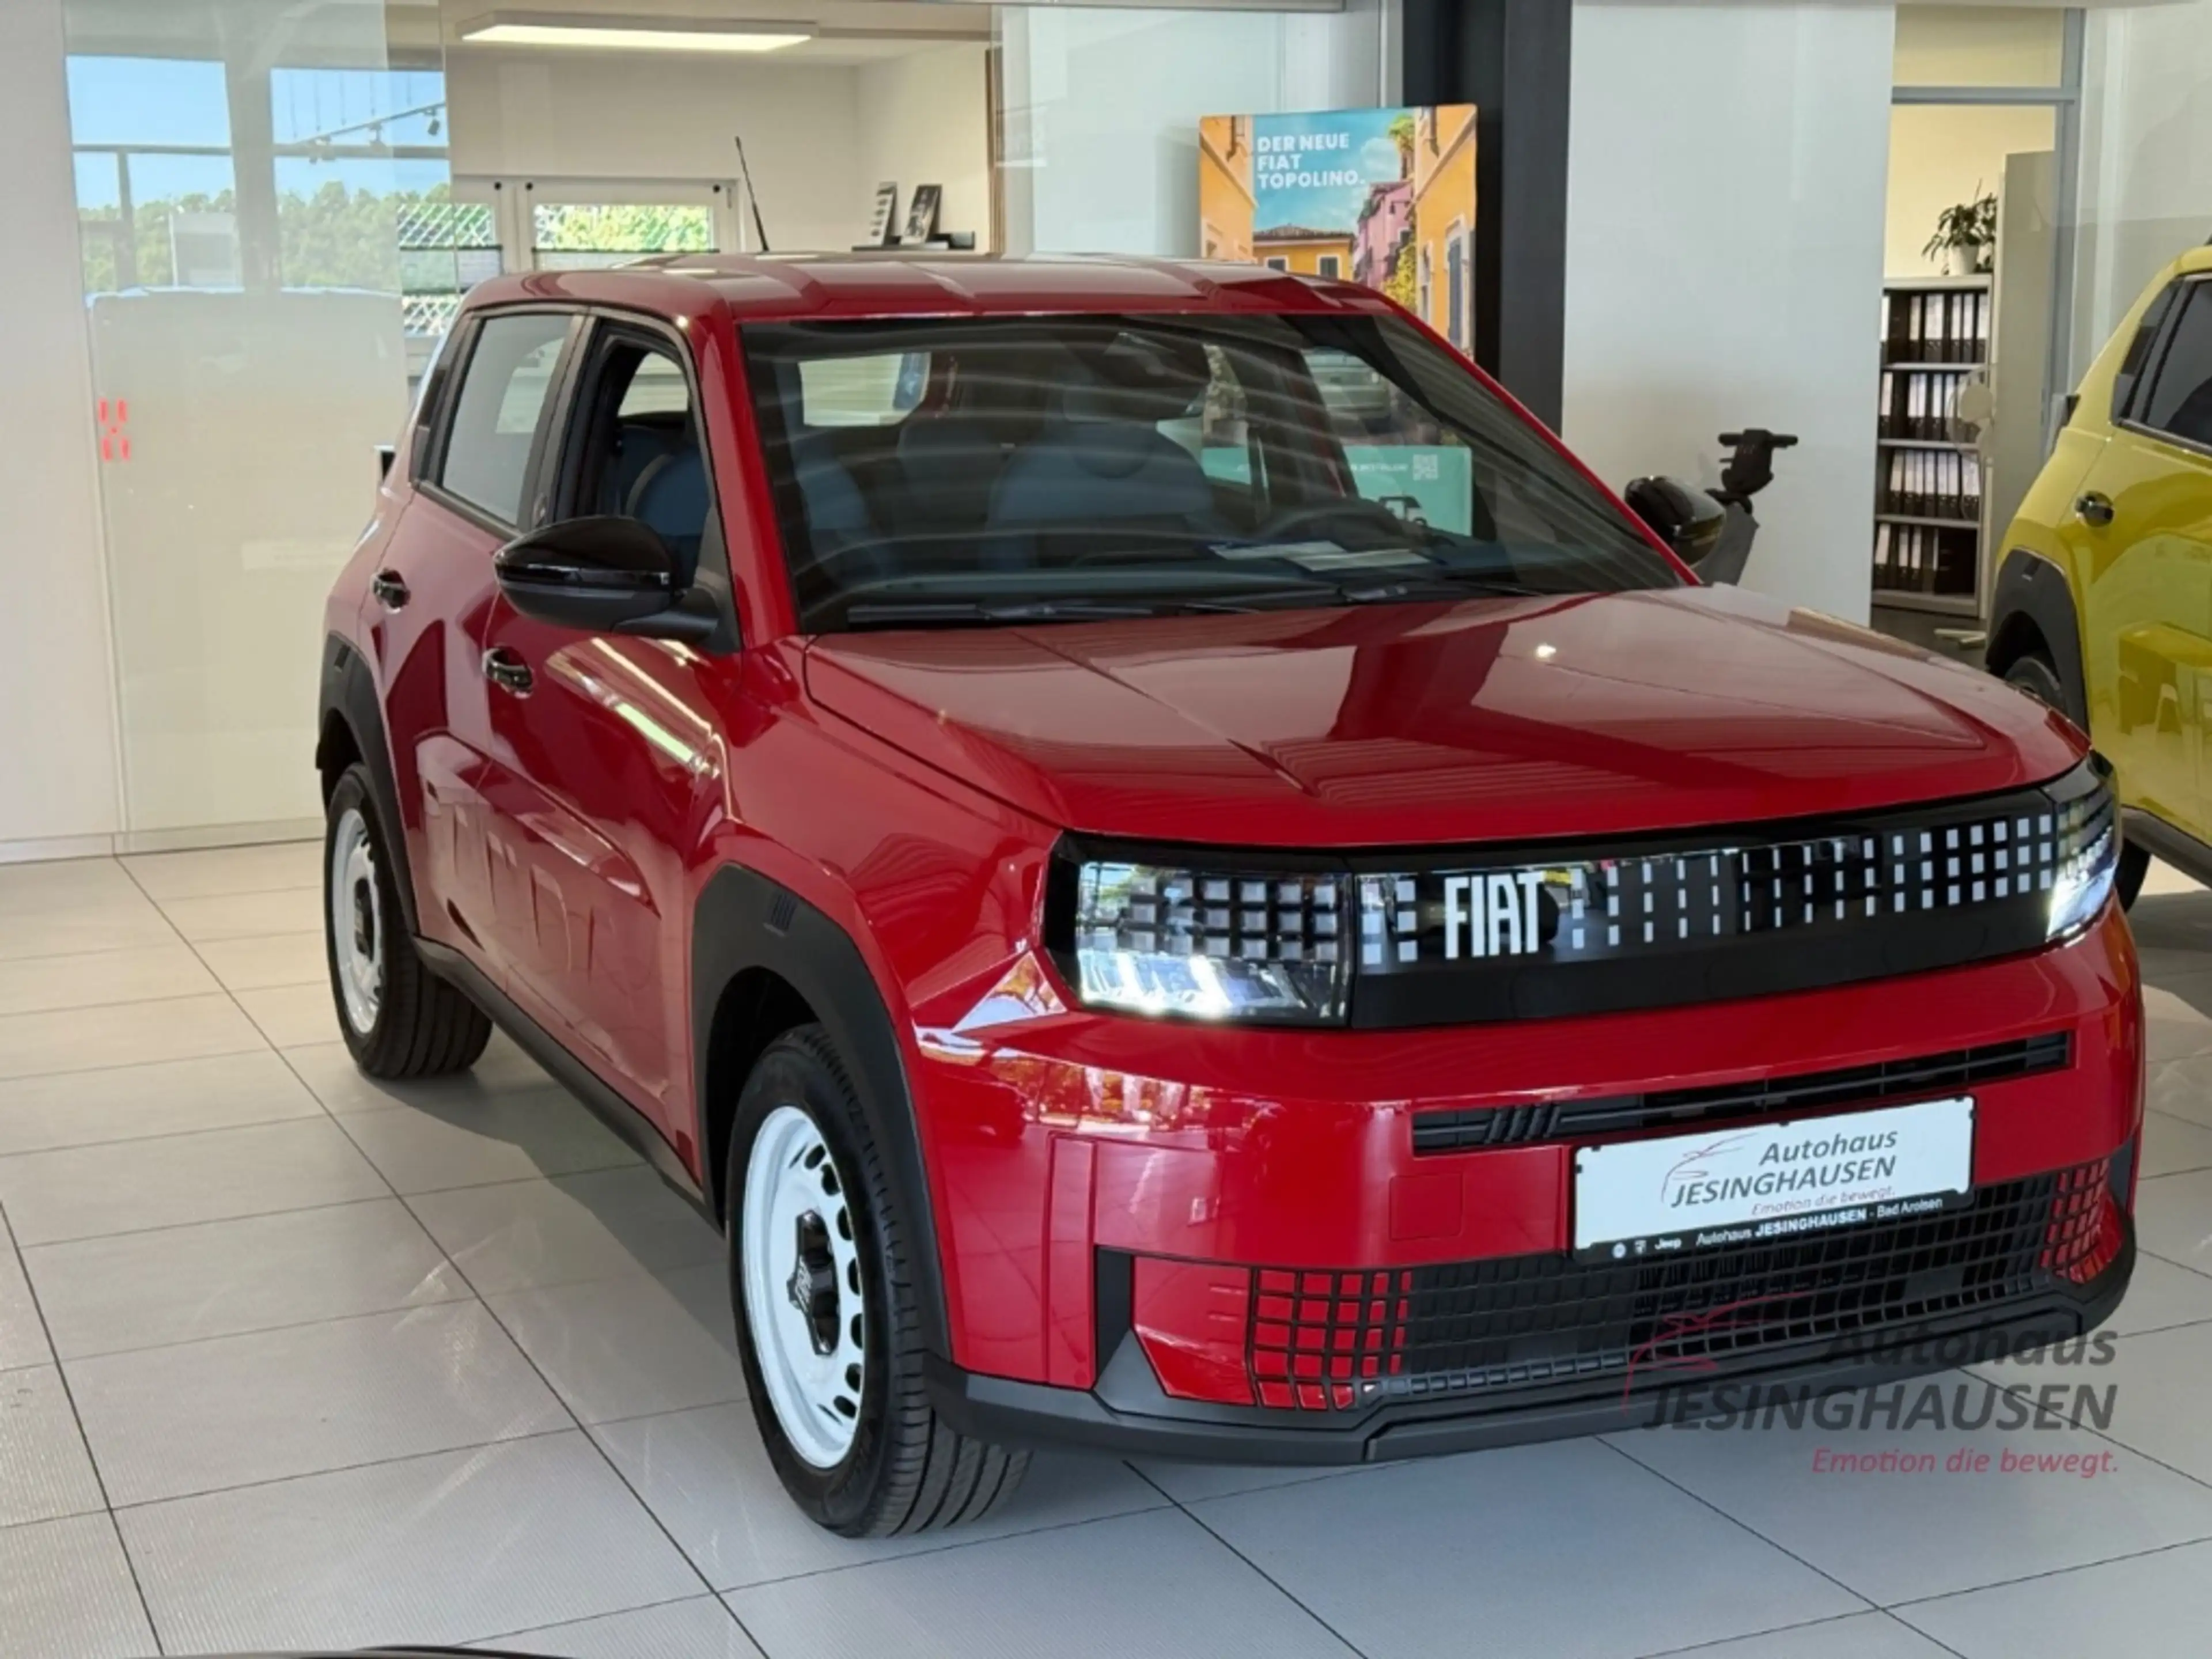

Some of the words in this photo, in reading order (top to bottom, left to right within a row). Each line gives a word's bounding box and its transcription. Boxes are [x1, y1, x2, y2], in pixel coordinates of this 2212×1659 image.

[1257, 135, 1295, 152] DER
[1300, 132, 1350, 150] NEUE
[1257, 154, 1302, 171] FIAT
[1258, 171, 1365, 189] TOPOLINO.
[1445, 871, 1544, 960] FIAT
[1759, 1131, 1897, 1166] Autohaus
[1671, 1155, 1896, 1207] JESINGHAUSEN
[1751, 1197, 1812, 1215] Emotion
[1815, 1192, 1837, 1205] die
[1695, 1228, 1752, 1247] Autohaus
[1755, 1209, 1867, 1237] JESINGHAUSEN
[1877, 1205, 1900, 1218] Bad
